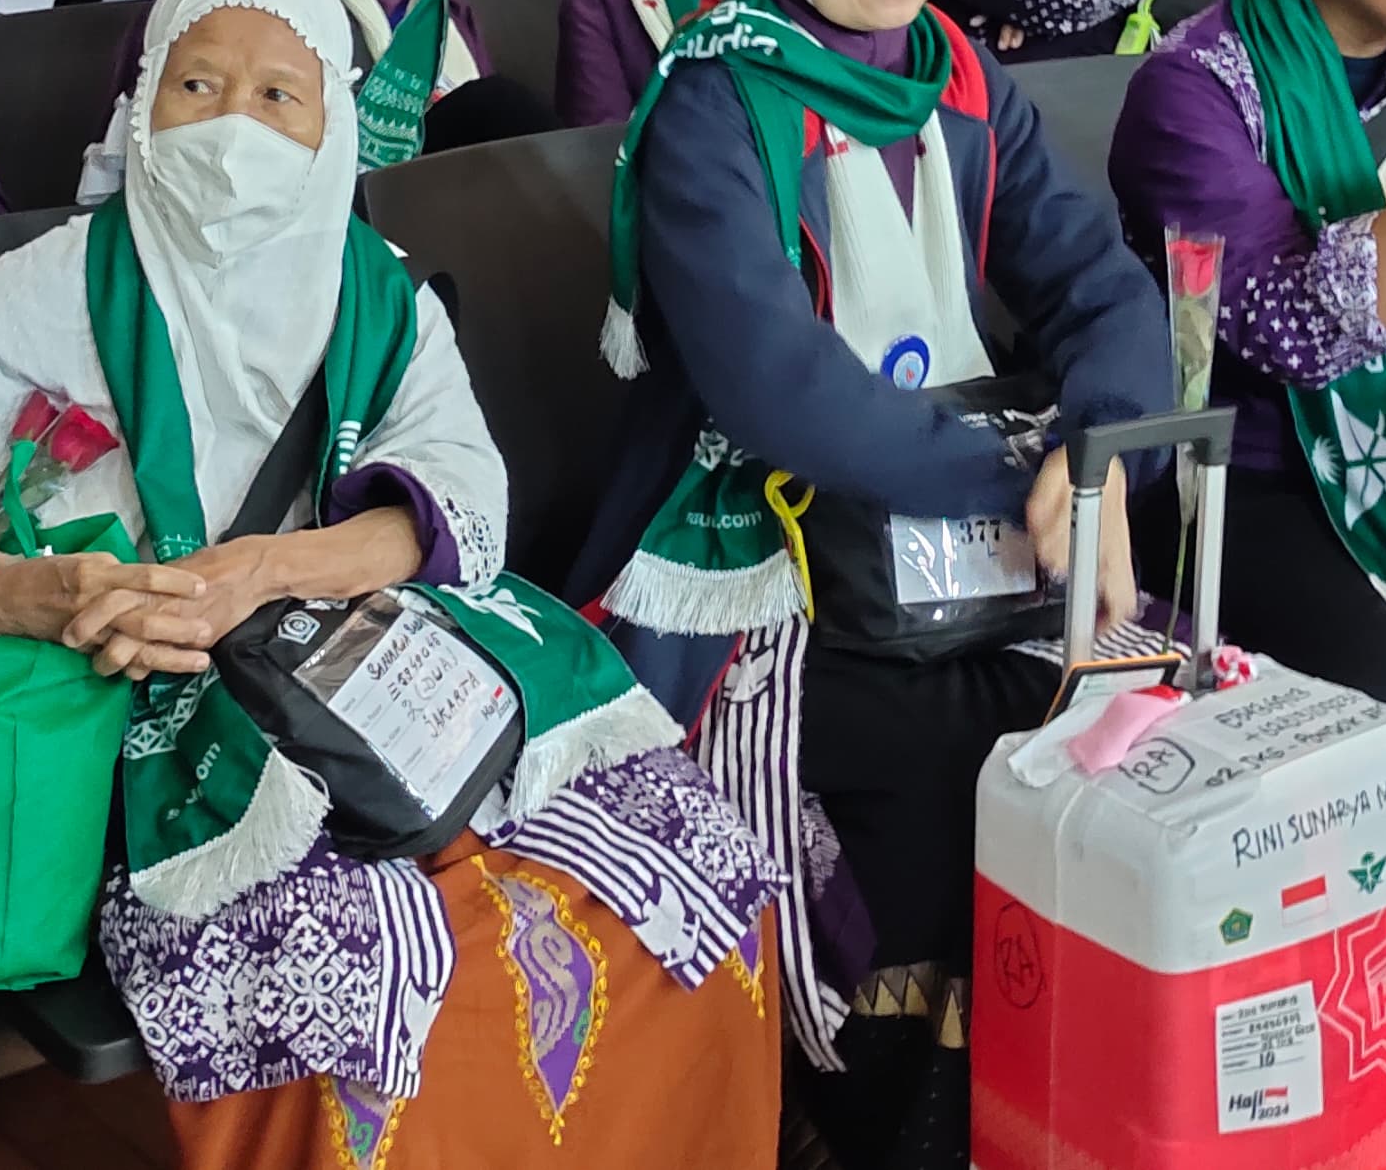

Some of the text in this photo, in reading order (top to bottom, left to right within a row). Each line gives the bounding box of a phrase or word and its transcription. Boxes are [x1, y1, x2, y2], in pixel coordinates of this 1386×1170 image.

[1232, 821, 1285, 869] RINI
[1227, 1088, 1264, 1123] Haji
[1257, 1103, 1291, 1121] 2024
